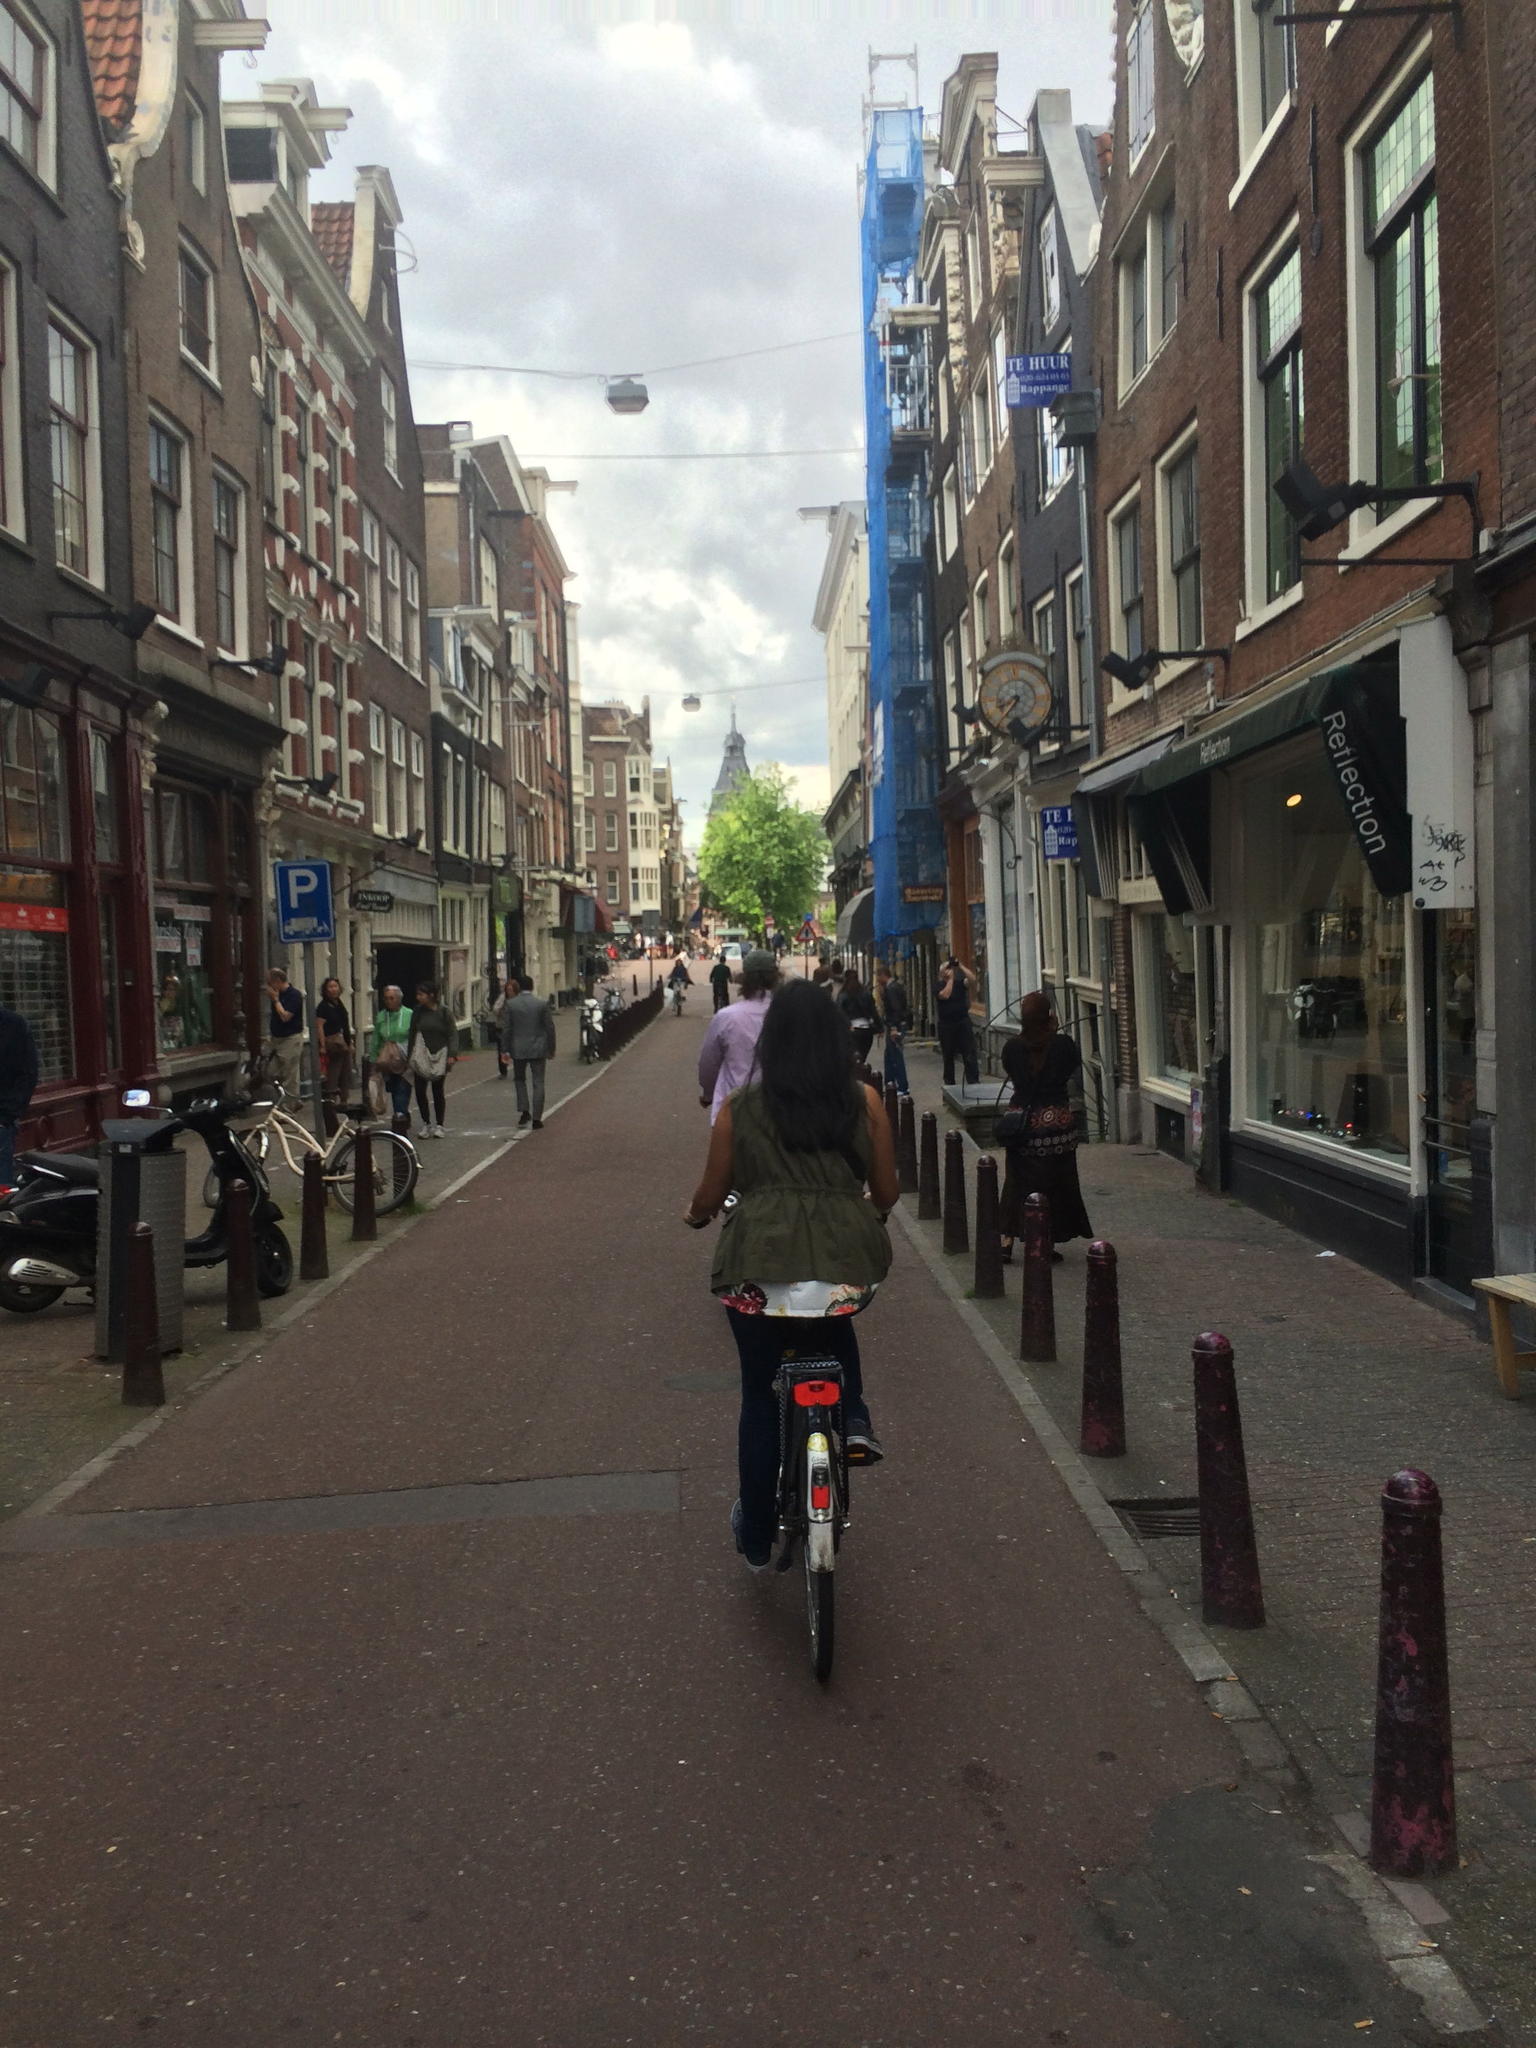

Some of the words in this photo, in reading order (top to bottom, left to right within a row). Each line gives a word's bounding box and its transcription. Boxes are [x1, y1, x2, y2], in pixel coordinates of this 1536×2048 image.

[1007, 357, 1024, 372] TE
[1029, 355, 1069, 370] HUUR
[1200, 736, 1230, 764] Reflection
[1323, 710, 1386, 855] Reflection
[1043, 809, 1061, 823] TE
[288, 868, 319, 909] P
